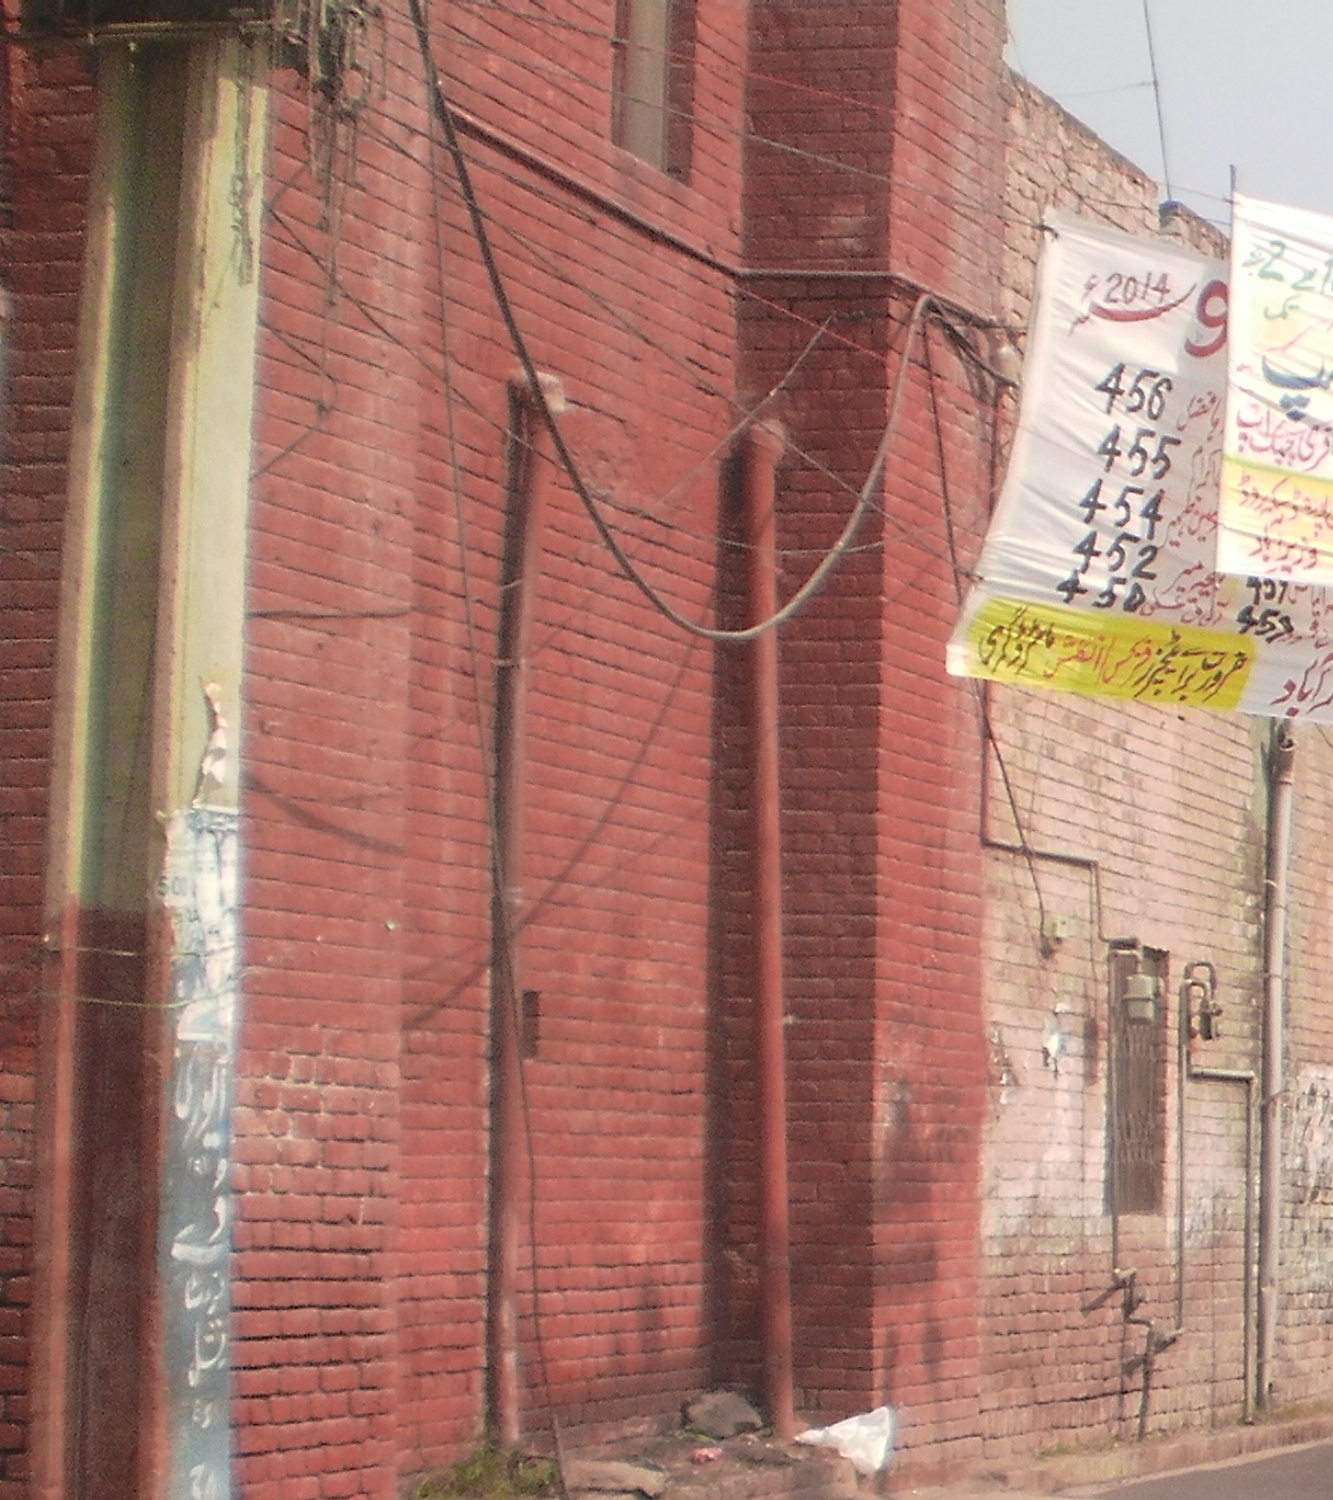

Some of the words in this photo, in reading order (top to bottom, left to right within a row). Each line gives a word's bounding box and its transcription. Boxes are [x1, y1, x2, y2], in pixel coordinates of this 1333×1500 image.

[1095, 362, 1173, 421] 456
[1097, 423, 1182, 480] 455
[1079, 477, 1166, 541] 454
[1072, 530, 1159, 581] 452
